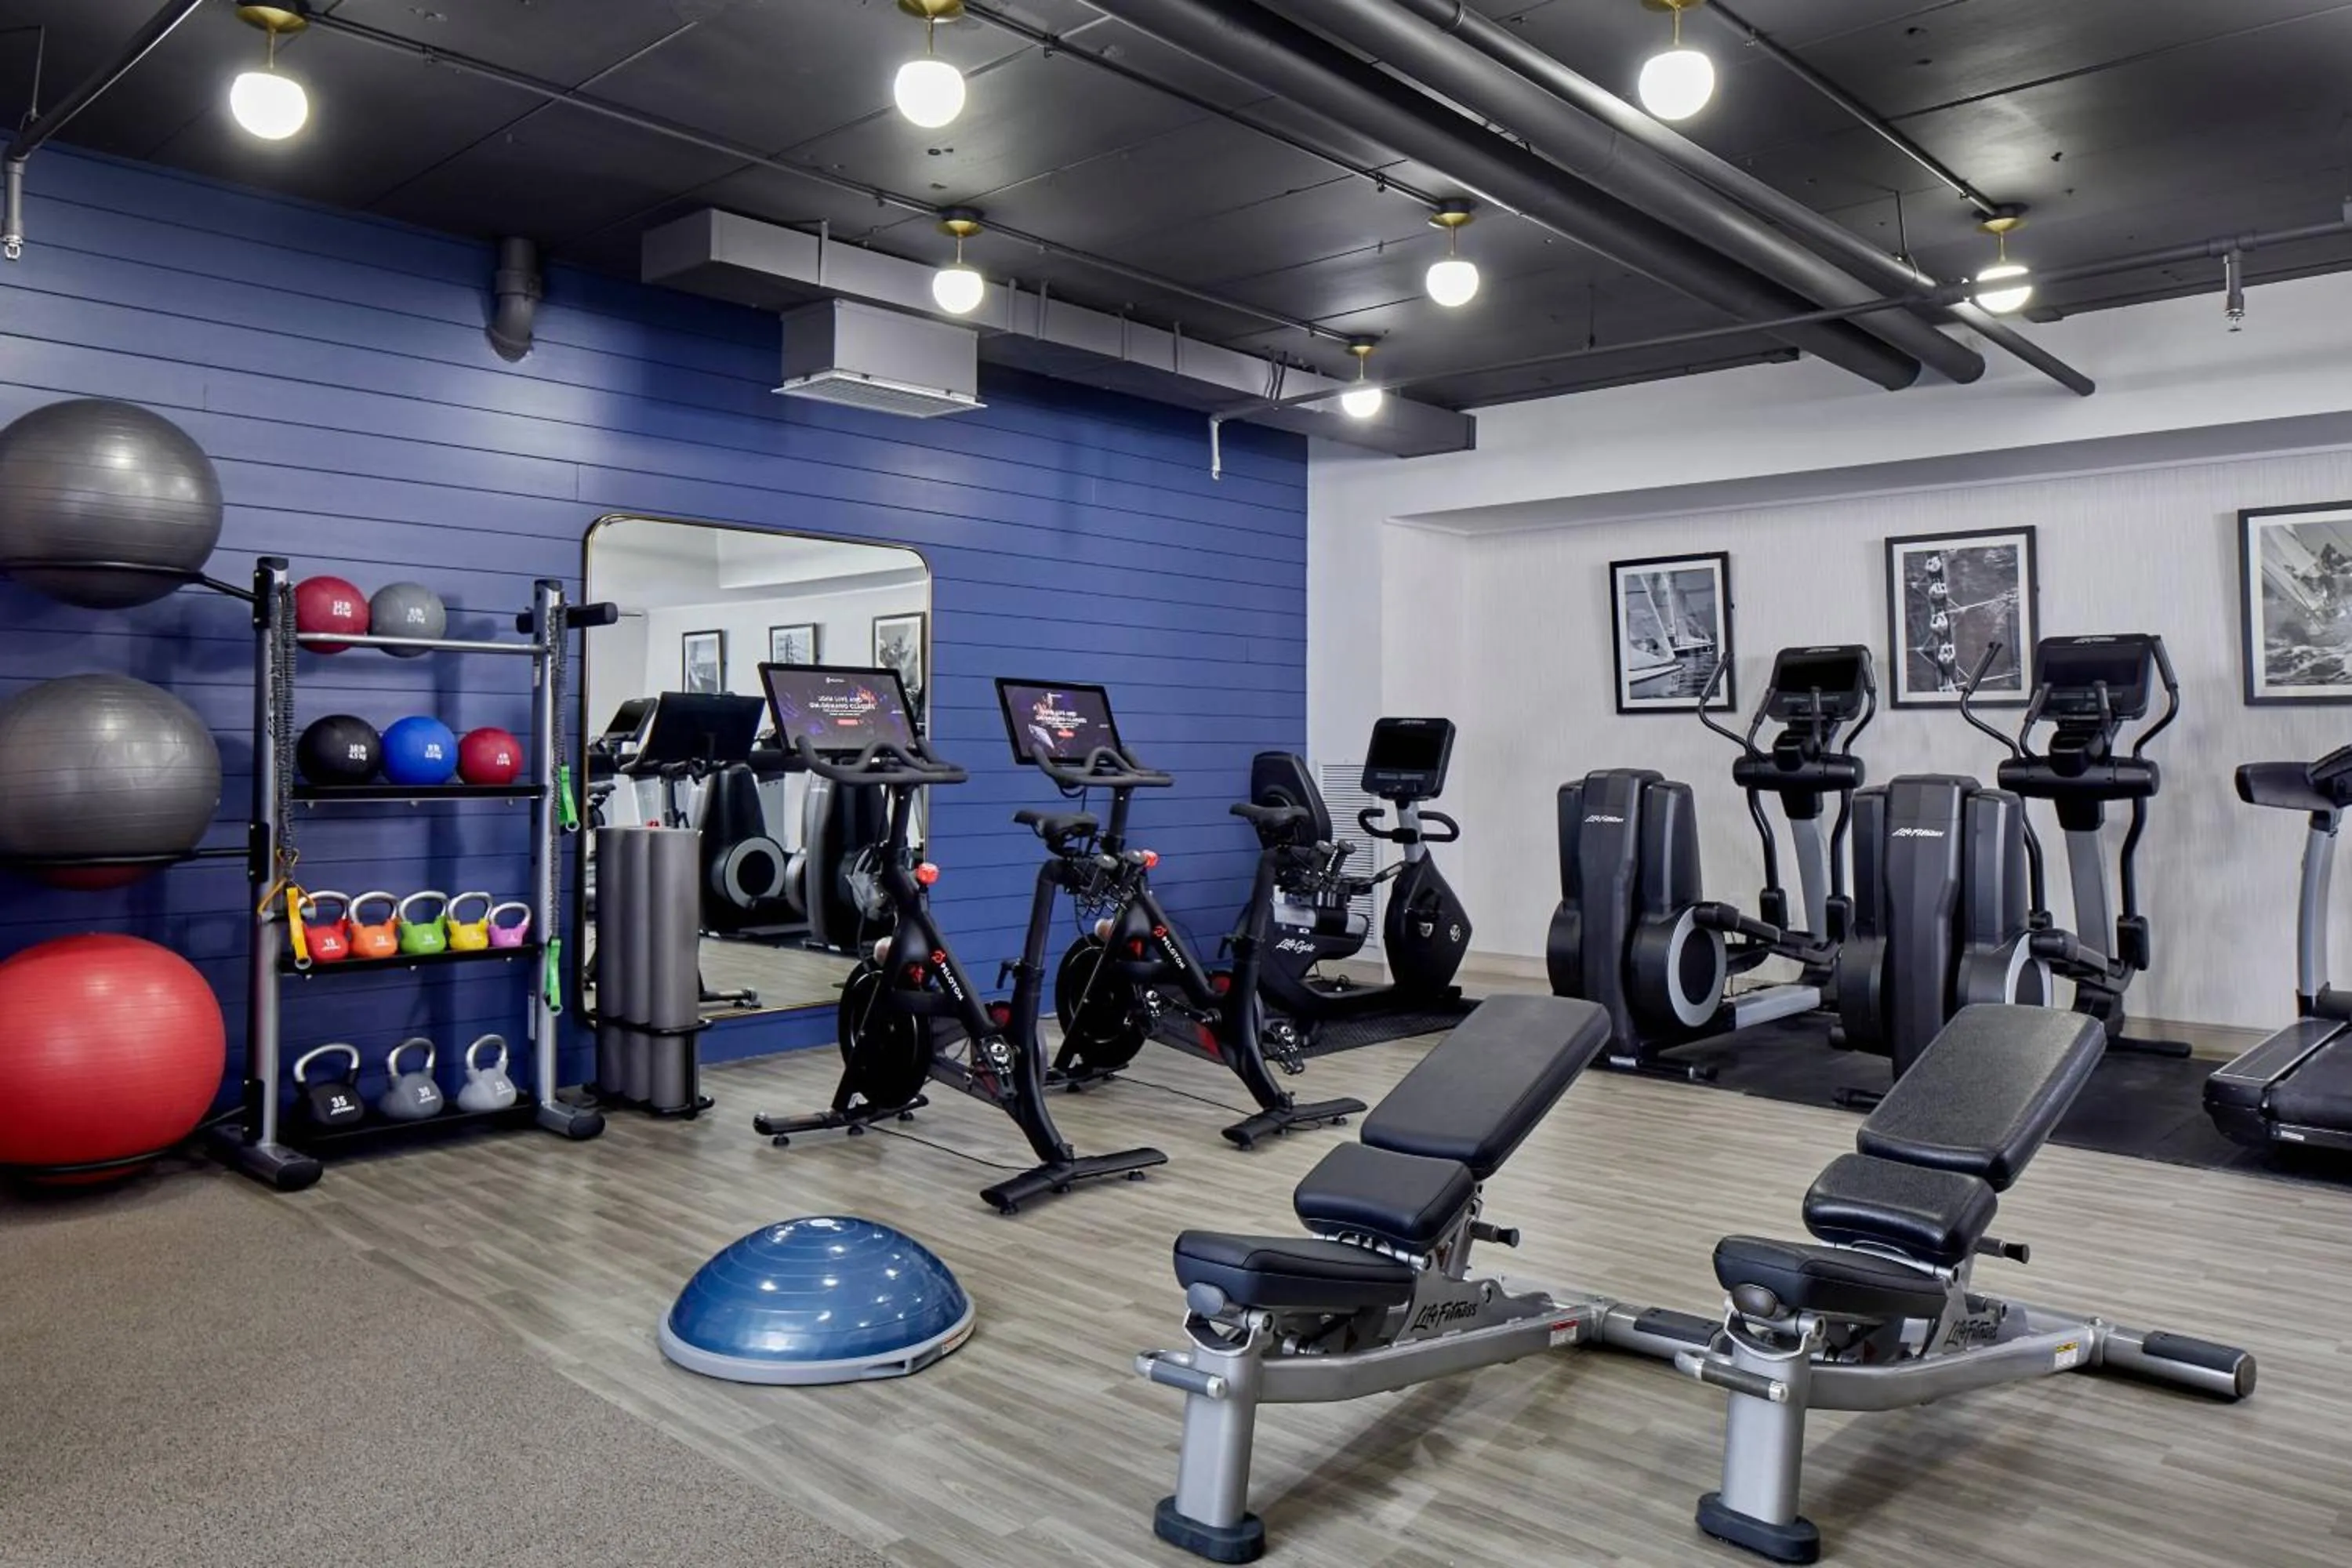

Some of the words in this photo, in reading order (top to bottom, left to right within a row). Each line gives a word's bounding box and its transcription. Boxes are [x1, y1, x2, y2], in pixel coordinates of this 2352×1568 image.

[1162, 936, 1186, 970] PELOTON
[940, 962, 964, 1001] PELOTON
[331, 1095, 347, 1108] 35
[1410, 1303, 1438, 1333] Life
[1435, 1301, 1478, 1329] Fitness
[1964, 1319, 1998, 1345] Fitness
